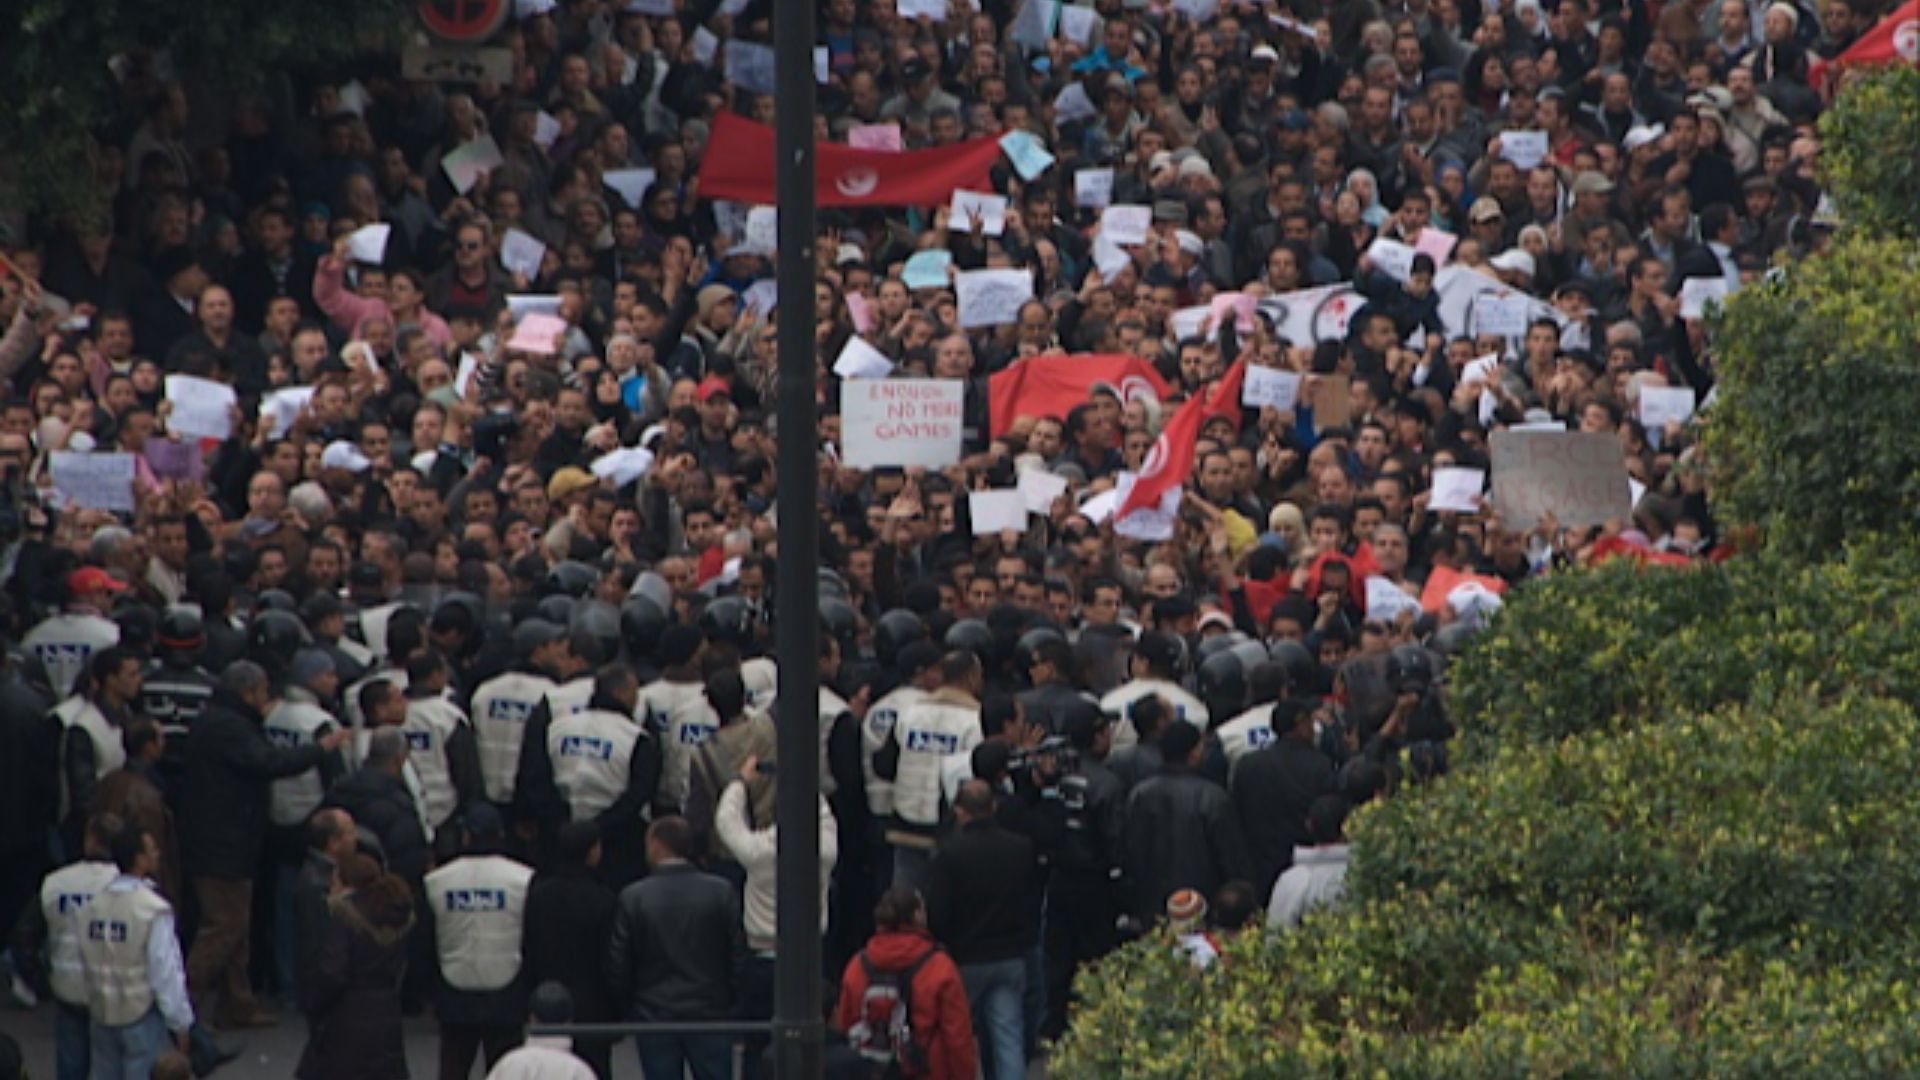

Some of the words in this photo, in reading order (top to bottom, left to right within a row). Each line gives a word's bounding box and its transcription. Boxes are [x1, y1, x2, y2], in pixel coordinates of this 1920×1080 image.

[869, 384, 943, 400] ENOUGH
[887, 402, 915, 419] NO
[874, 423, 952, 440] GAMES
